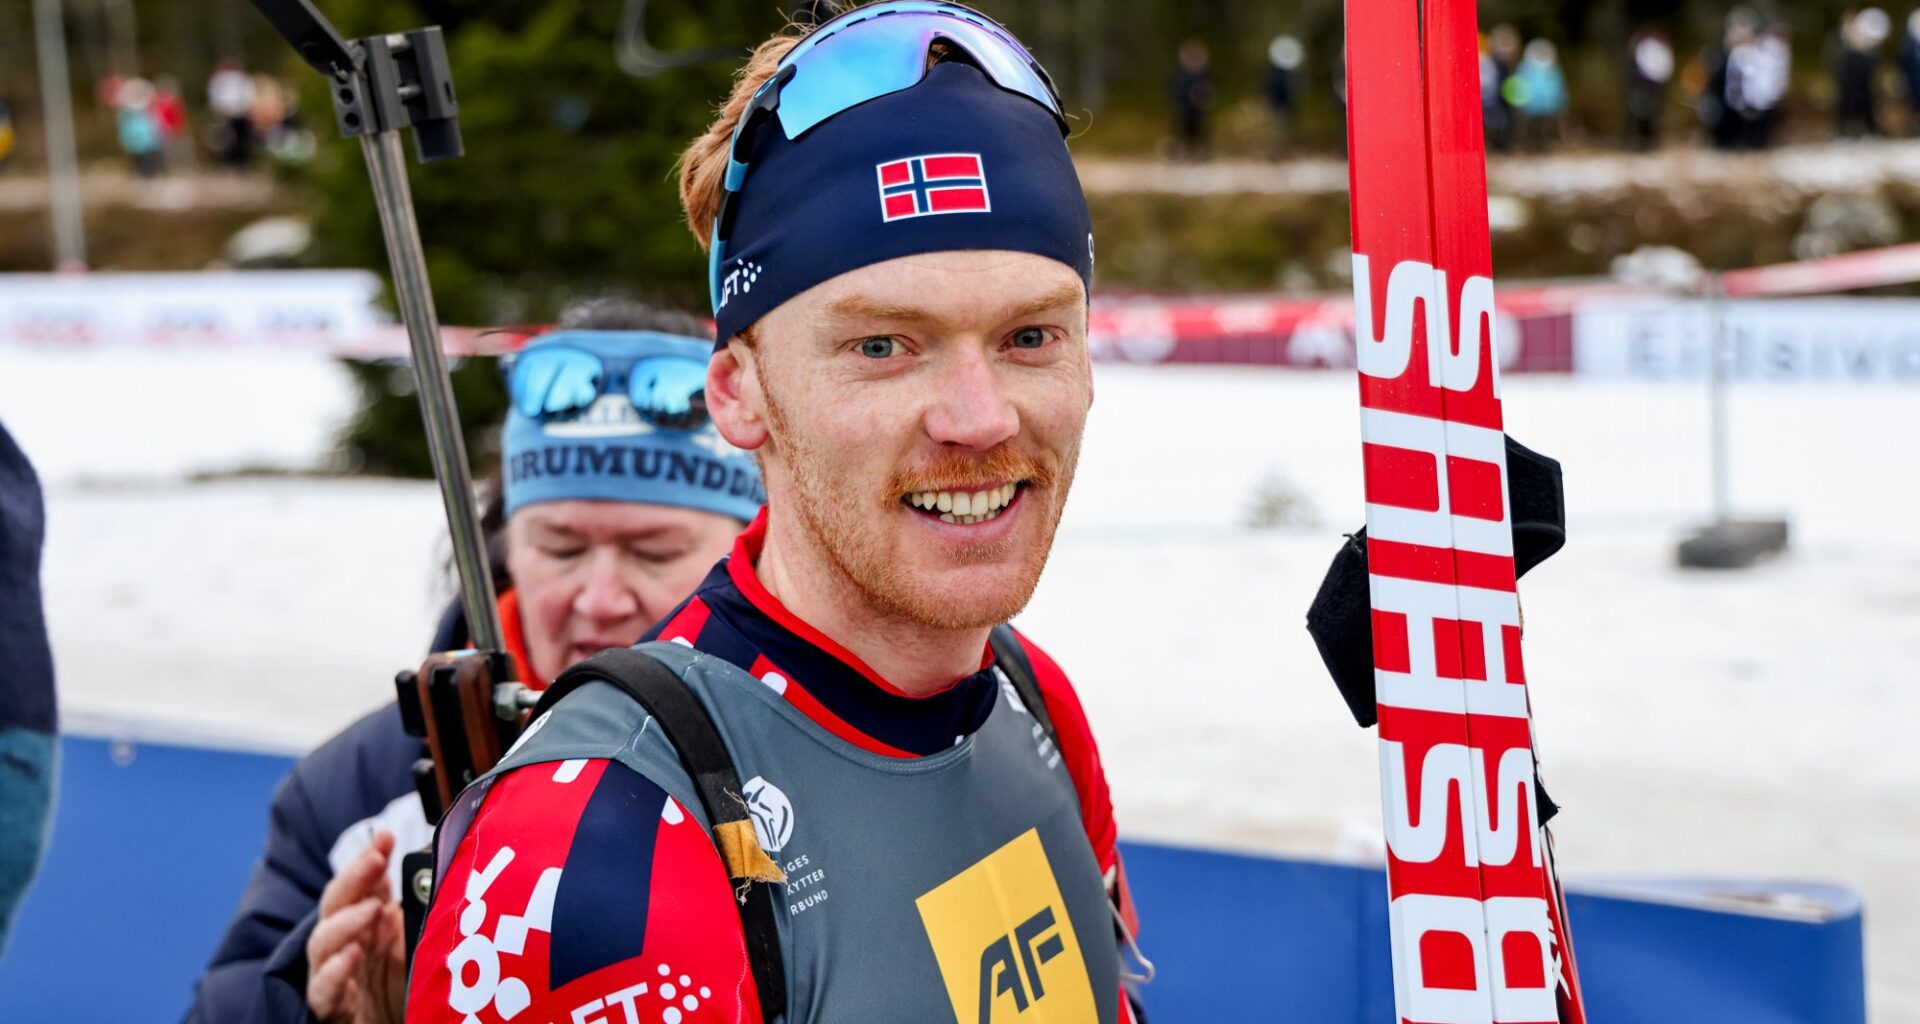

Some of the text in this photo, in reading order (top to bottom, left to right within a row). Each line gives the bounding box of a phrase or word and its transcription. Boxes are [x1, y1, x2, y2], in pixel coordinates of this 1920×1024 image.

[789, 889, 829, 916] RBUND
[978, 904, 1065, 1024] AF
[545, 981, 649, 1024] FT
